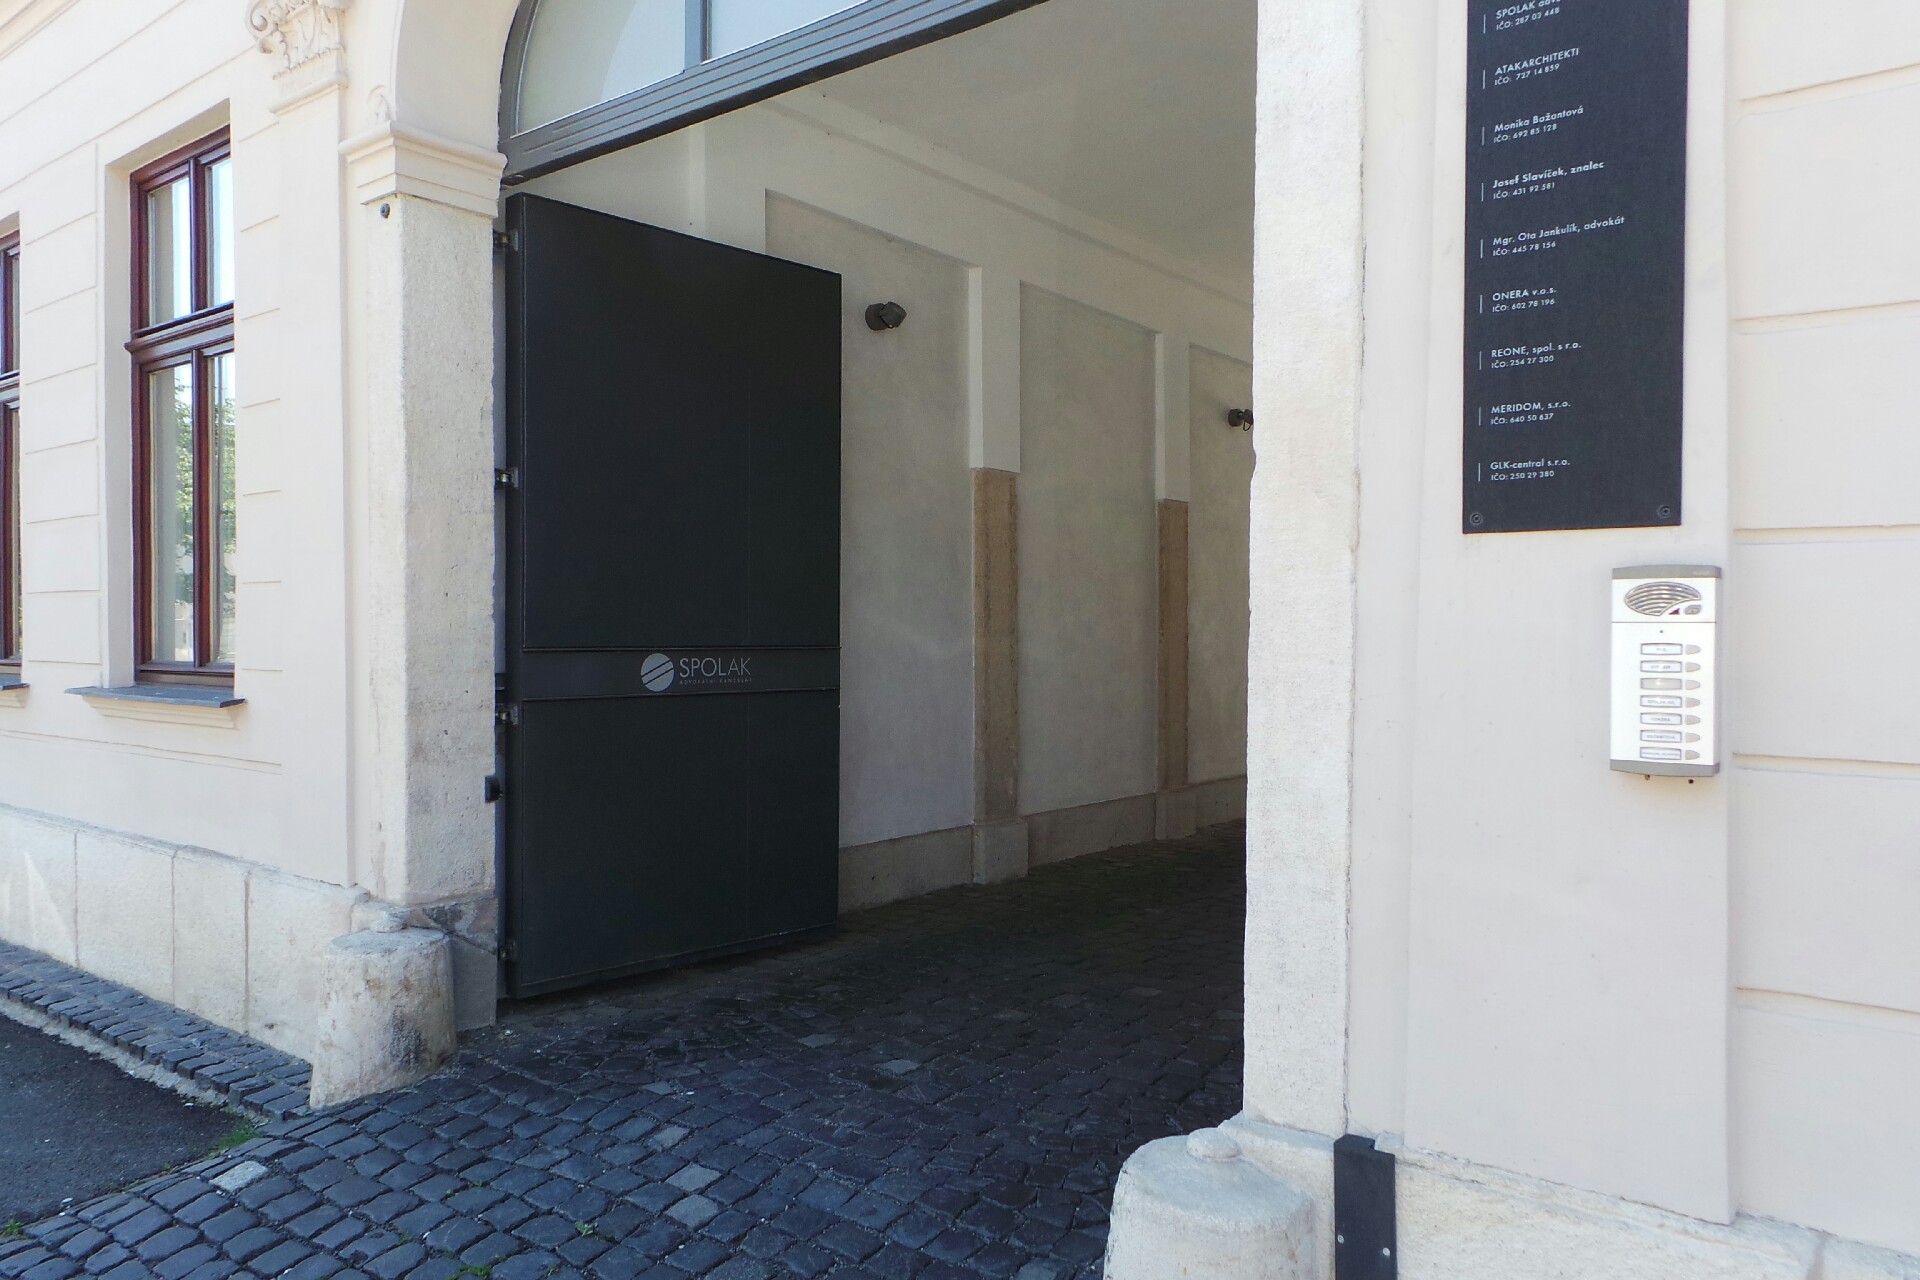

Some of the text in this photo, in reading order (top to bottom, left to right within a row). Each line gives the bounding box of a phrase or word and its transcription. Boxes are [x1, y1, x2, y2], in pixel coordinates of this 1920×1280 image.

[1496, 0, 1536, 19] SPOLAK
[1496, 21, 1513, 30] IČO:
[1515, 14, 1530, 26] 287
[1544, 7, 1560, 16] 448
[1495, 48, 1579, 76] ATAKARCHITEKTI
[1494, 76, 1512, 86] IČO:
[1516, 70, 1530, 80] 727
[1544, 63, 1560, 72] 859
[1494, 105, 1584, 133] Monika Bažantová
[1493, 133, 1511, 143] IČO:
[1513, 130, 1528, 139] 692
[1543, 123, 1557, 132] 128
[1493, 161, 1605, 188] Josef Slavíček, znalec
[1493, 182, 1555, 200] IČO: 431 92 581
[1492, 216, 1625, 246] Mgr. Ota Jankulík, advokát
[1492, 246, 1510, 256] IČO:
[1512, 245, 1527, 253] 445
[1542, 240, 1556, 249] 156
[1492, 287, 1557, 301] ONERA v.o.s.
[1492, 304, 1510, 312] IČO:
[1511, 302, 1526, 310] 602
[1491, 346, 1530, 358] REONE,
[1532, 342, 1555, 354] spol.
[1491, 360, 1509, 368] IČO:
[1510, 358, 1525, 366] 254
[1539, 355, 1554, 363] 300
[1491, 402, 1544, 414] MERIDOM,
[1491, 416, 1508, 425] IČO:
[1510, 416, 1525, 424] 640
[1490, 458, 1545, 470] GLK-central
[1491, 472, 1508, 480] IČO:
[680, 658, 750, 677] SPOLAK
